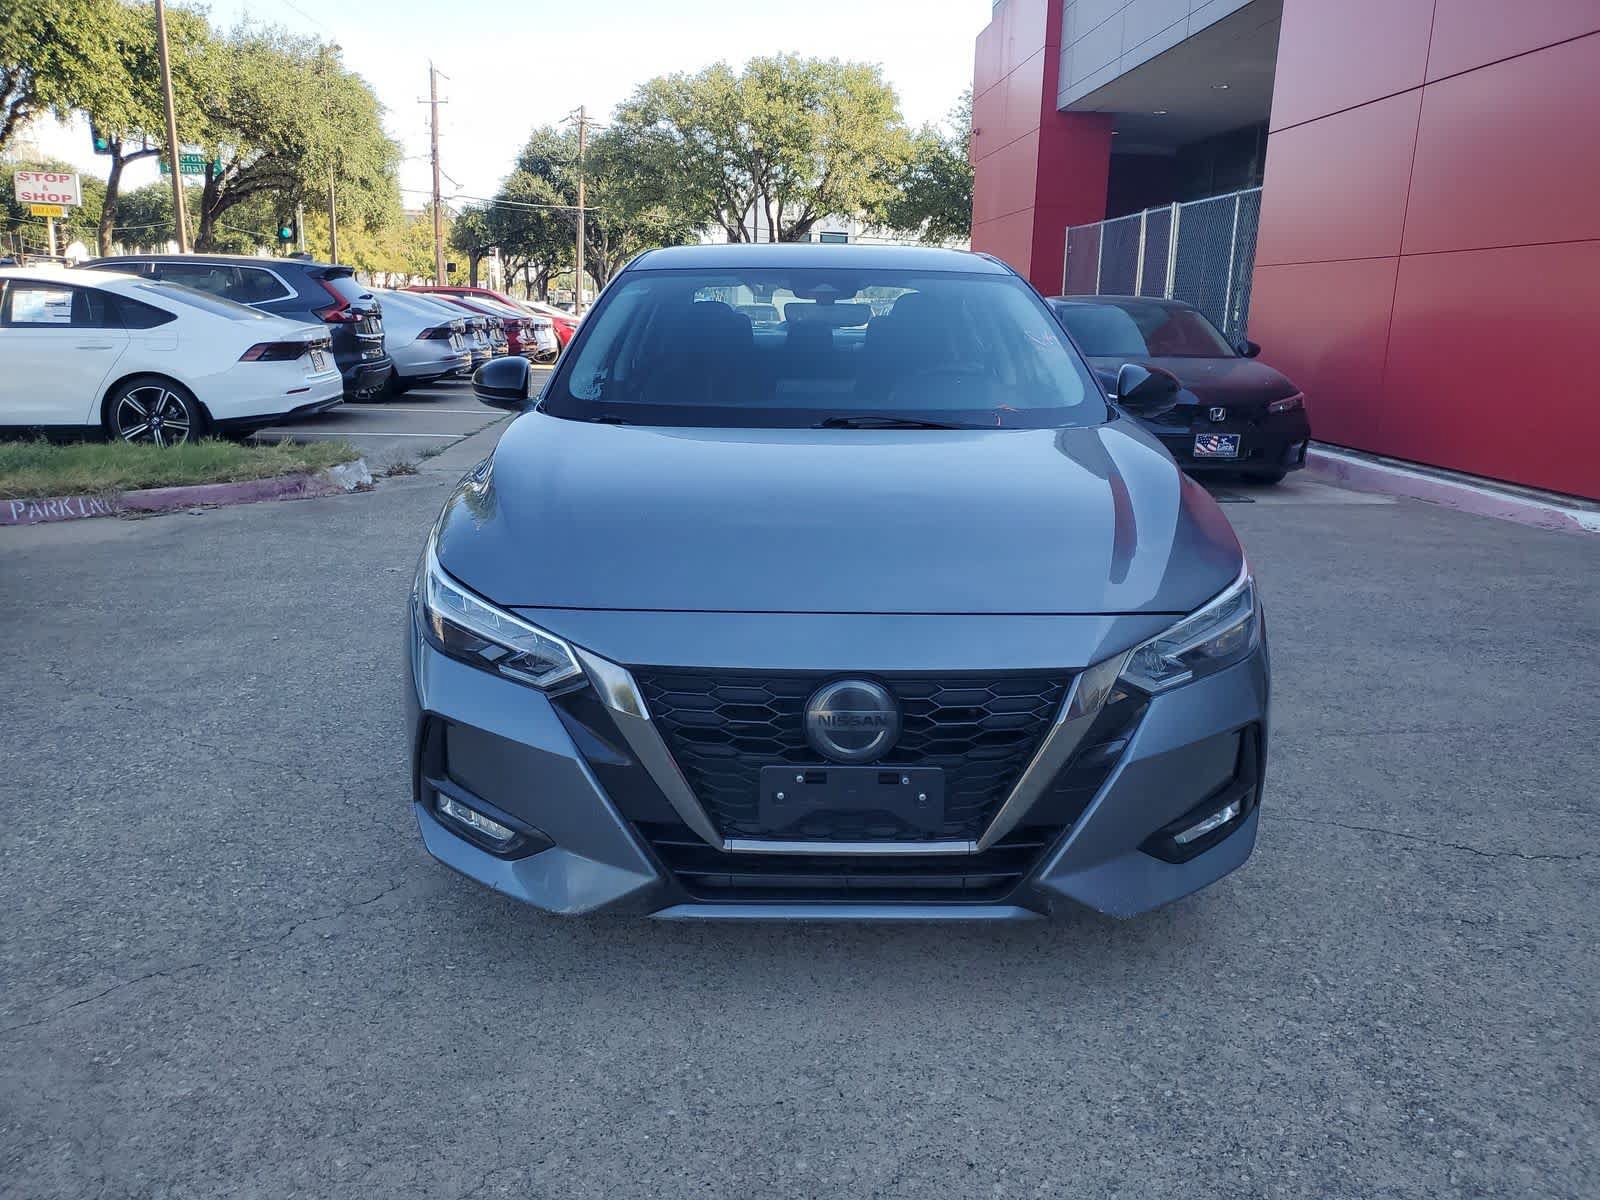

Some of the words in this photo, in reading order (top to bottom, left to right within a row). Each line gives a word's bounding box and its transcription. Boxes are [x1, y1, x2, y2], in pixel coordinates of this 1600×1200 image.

[16, 172, 70, 183] STOP
[21, 192, 73, 203] SHOP
[818, 715, 888, 728] NISSAN
